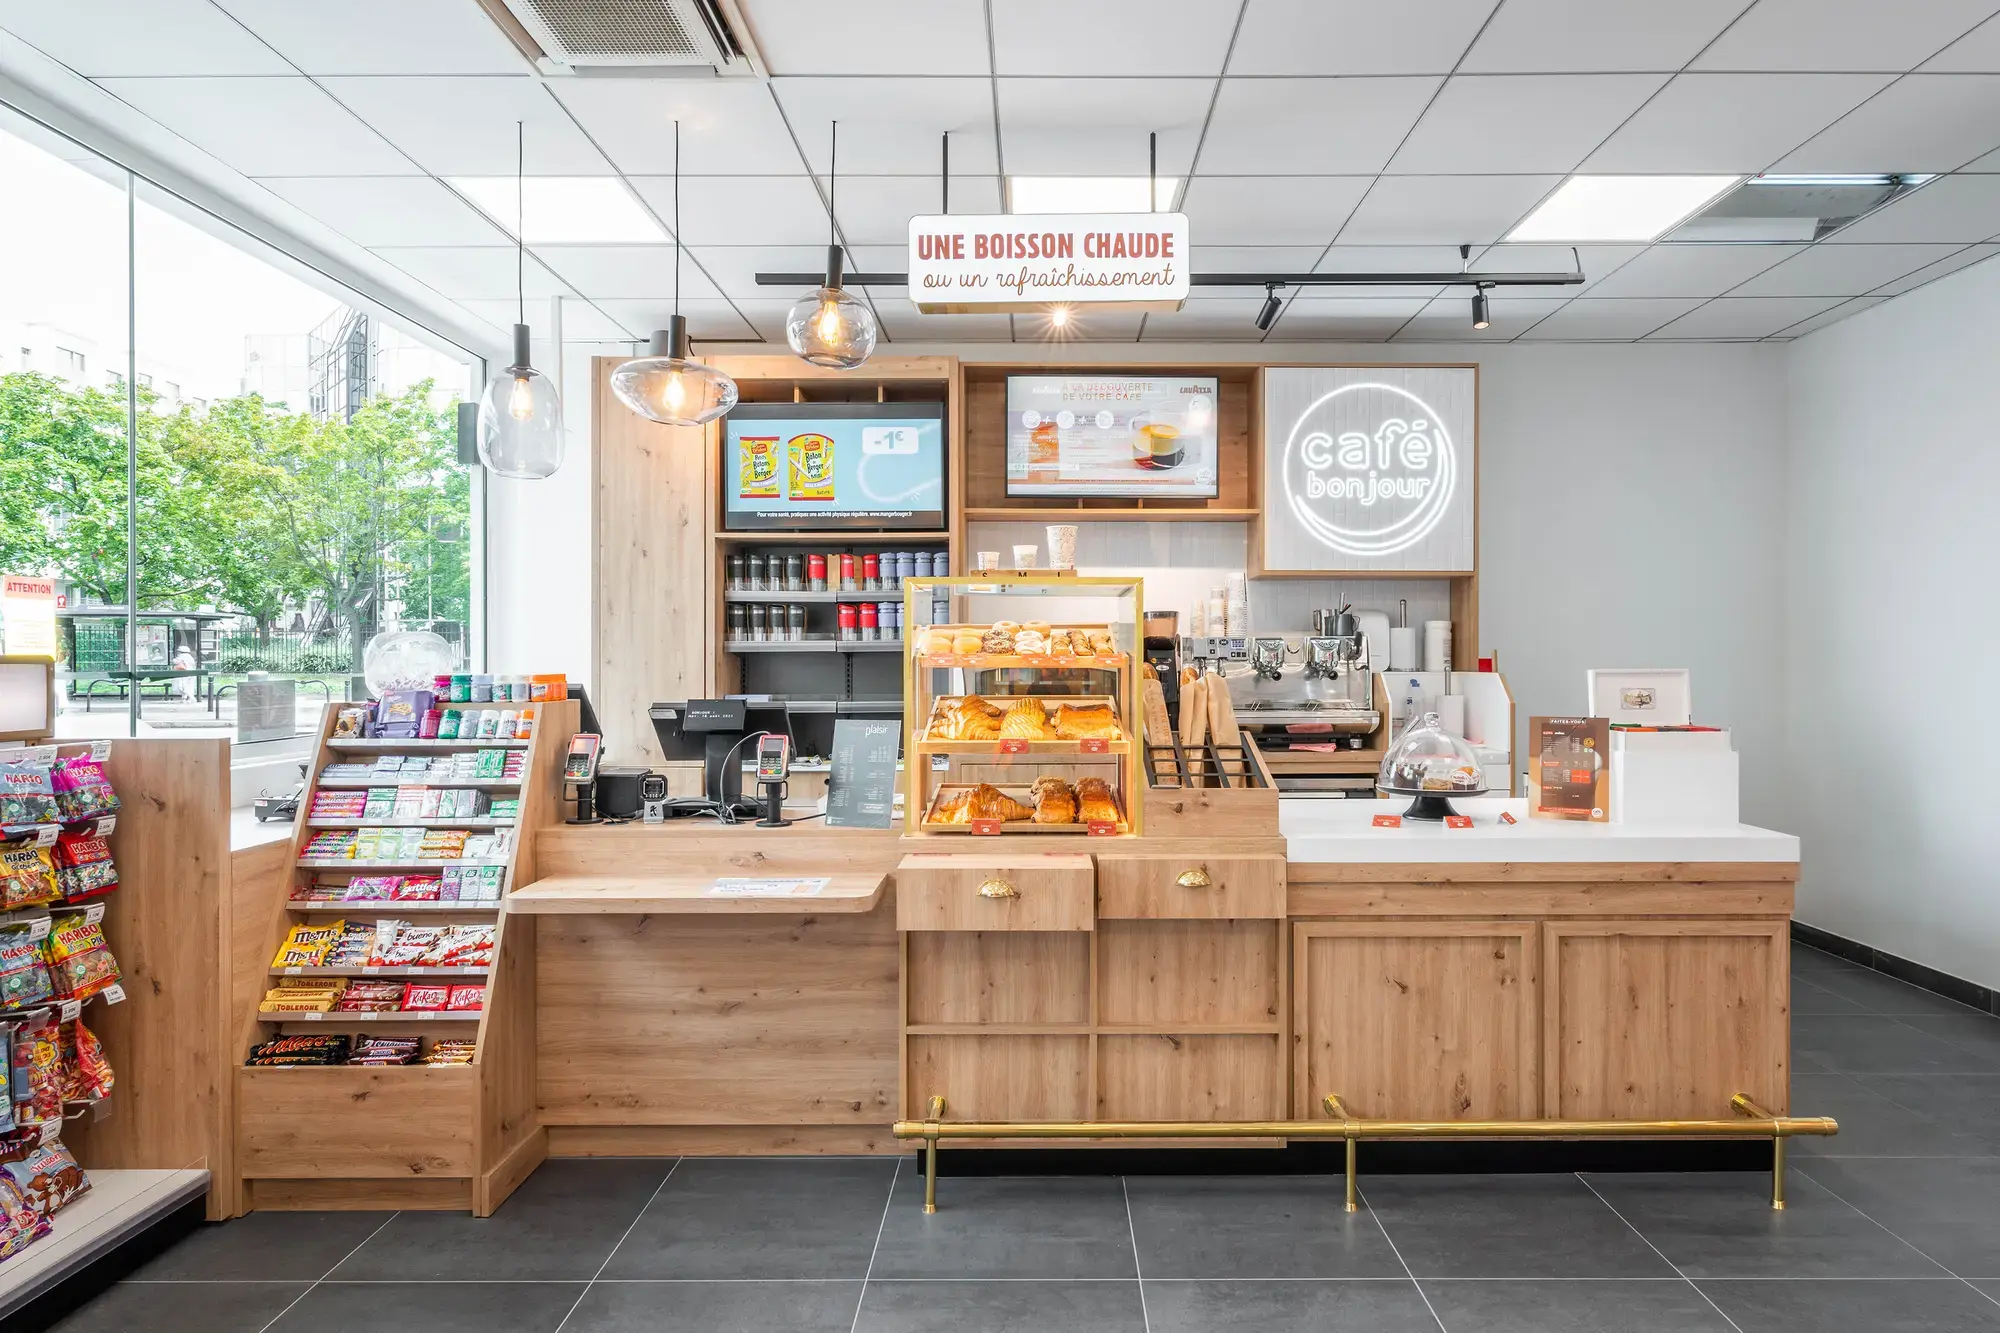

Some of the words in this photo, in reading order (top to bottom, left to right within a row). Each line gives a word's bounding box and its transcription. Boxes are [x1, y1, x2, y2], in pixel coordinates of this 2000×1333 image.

[918, 234, 965, 260] UNE
[974, 232, 1074, 259] BOISSON
[1083, 232, 1174, 258] CHAUDE
[923, 273, 952, 288] ou
[959, 272, 989, 288] un
[996, 263, 1176, 296] rafraîchissement
[1079, 393, 1113, 401] VOTRE
[1301, 418, 1432, 470] café
[1307, 470, 1430, 506] bonjour
[7, 581, 51, 595] ATTENTION
[865, 723, 888, 738] plaisir
[58, 923, 99, 945] HARIBO
[407, 932, 433, 941] bueno
[297, 980, 338, 988] TOBLERONE
[276, 1003, 319, 1011] TOBLERONE
